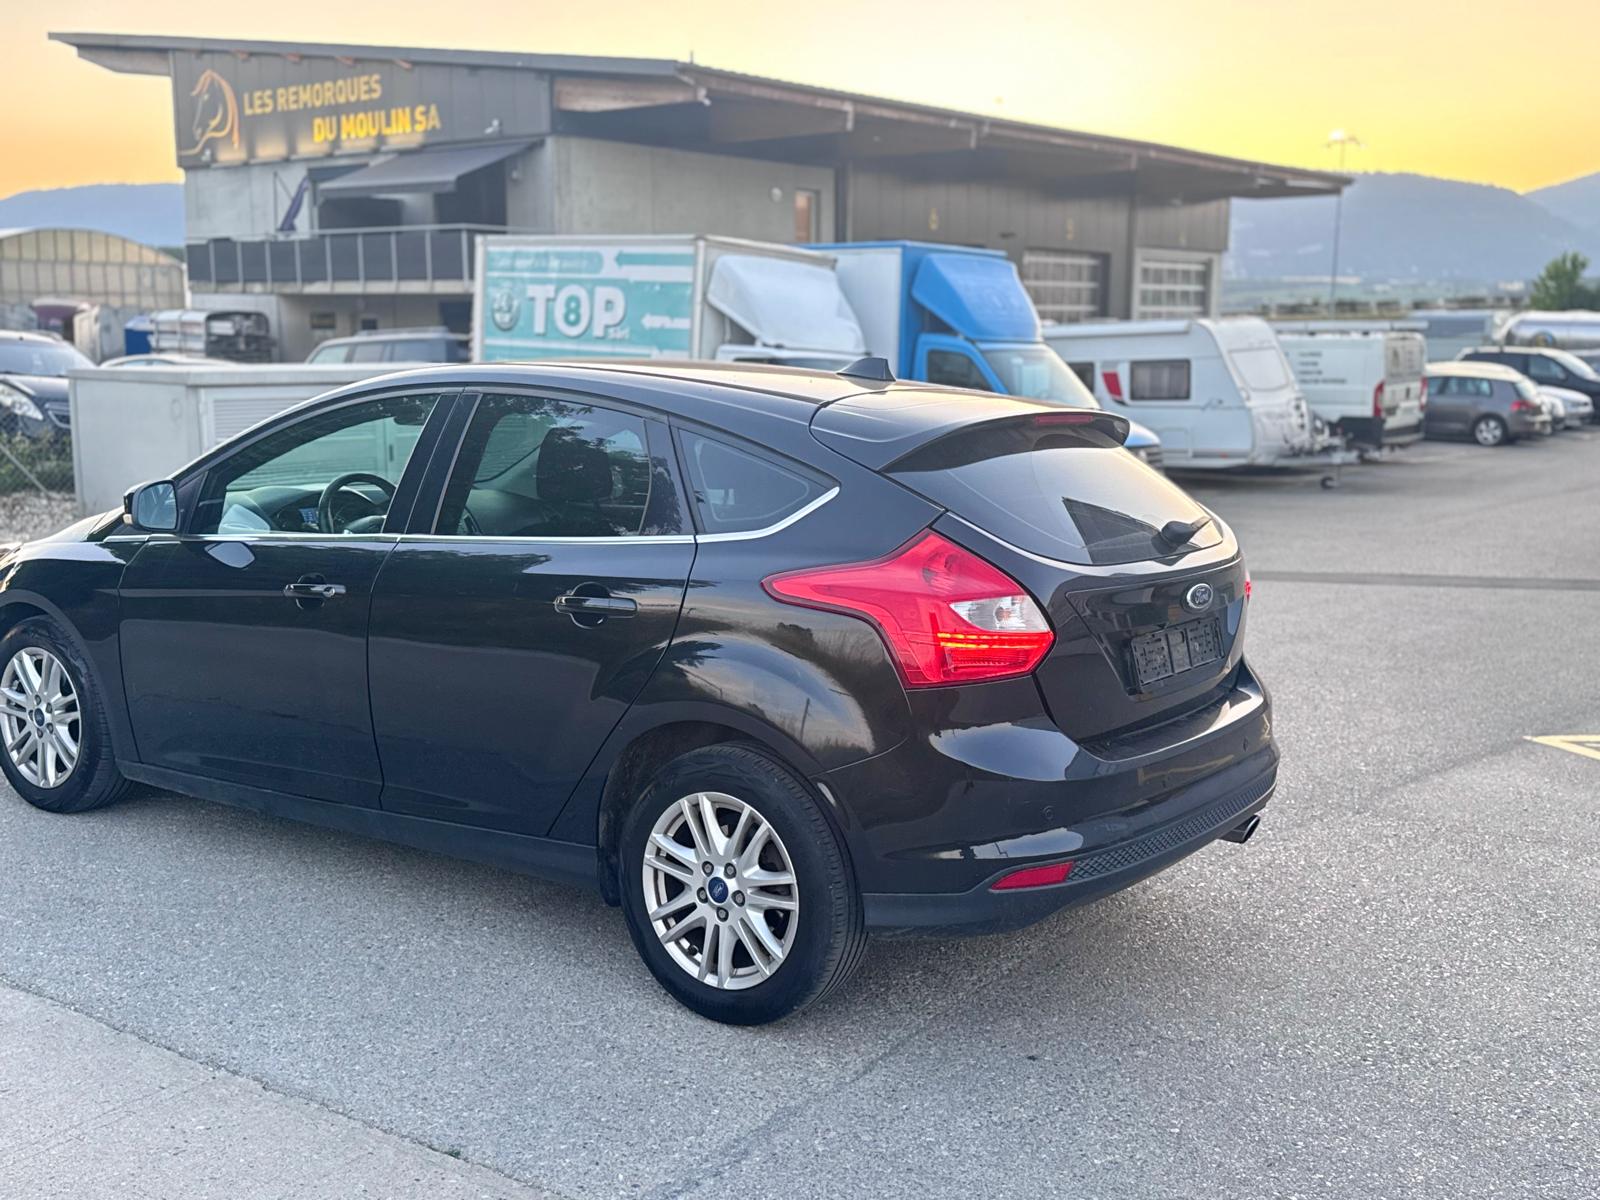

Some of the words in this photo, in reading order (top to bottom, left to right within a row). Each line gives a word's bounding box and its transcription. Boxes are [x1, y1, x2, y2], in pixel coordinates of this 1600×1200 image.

[244, 90, 273, 115] LES
[277, 75, 382, 111] REMORQUES
[312, 115, 338, 143] DU
[340, 106, 412, 140] MOULIN
[414, 104, 442, 133] SA
